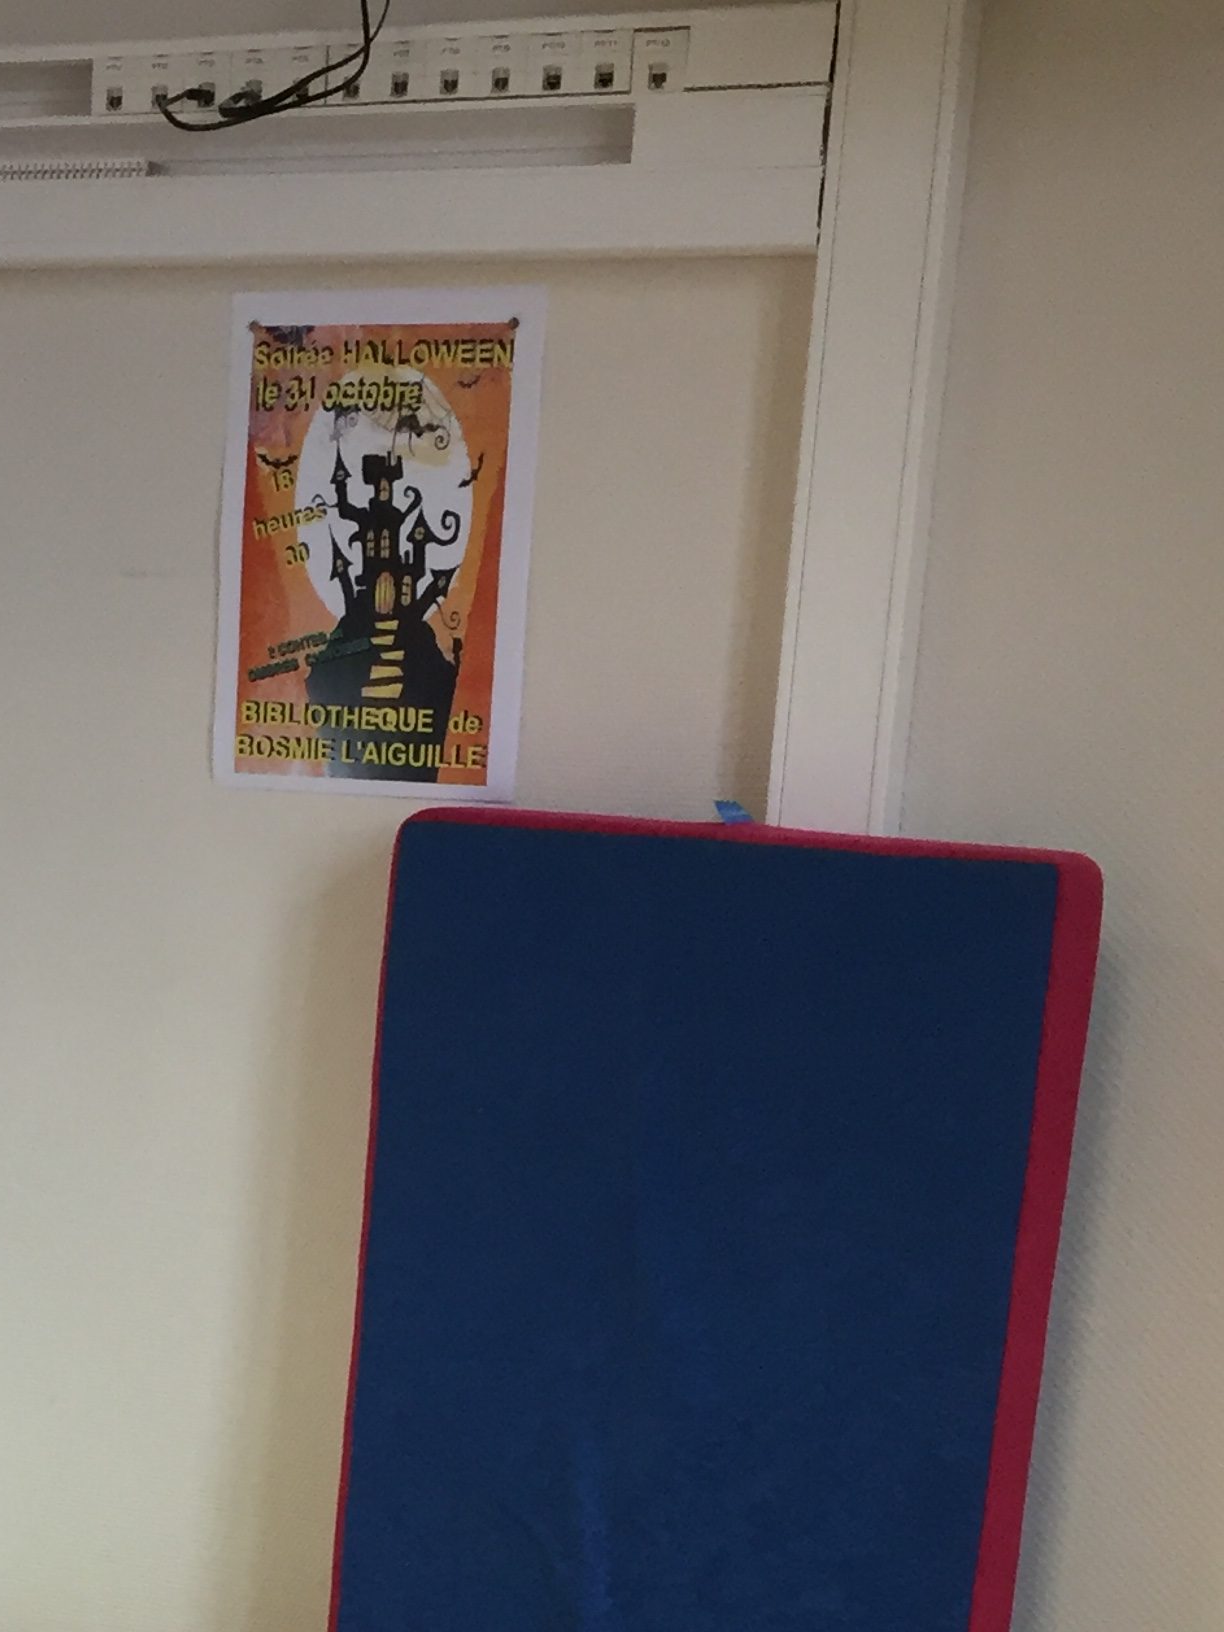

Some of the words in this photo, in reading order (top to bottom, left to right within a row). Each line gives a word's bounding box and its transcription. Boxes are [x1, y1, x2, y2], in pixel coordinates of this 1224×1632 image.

[254, 338, 334, 371] Soirée
[343, 338, 515, 369] HALLOWEEN
[255, 375, 281, 411] le
[285, 374, 317, 411] 31
[321, 375, 424, 412] octobre
[252, 502, 328, 541] heures
[240, 700, 434, 734] BIBLIOTHEQUE
[448, 709, 483, 736] de
[235, 733, 336, 762] BOSMIE
[340, 740, 489, 770] L'AIGUILLE
